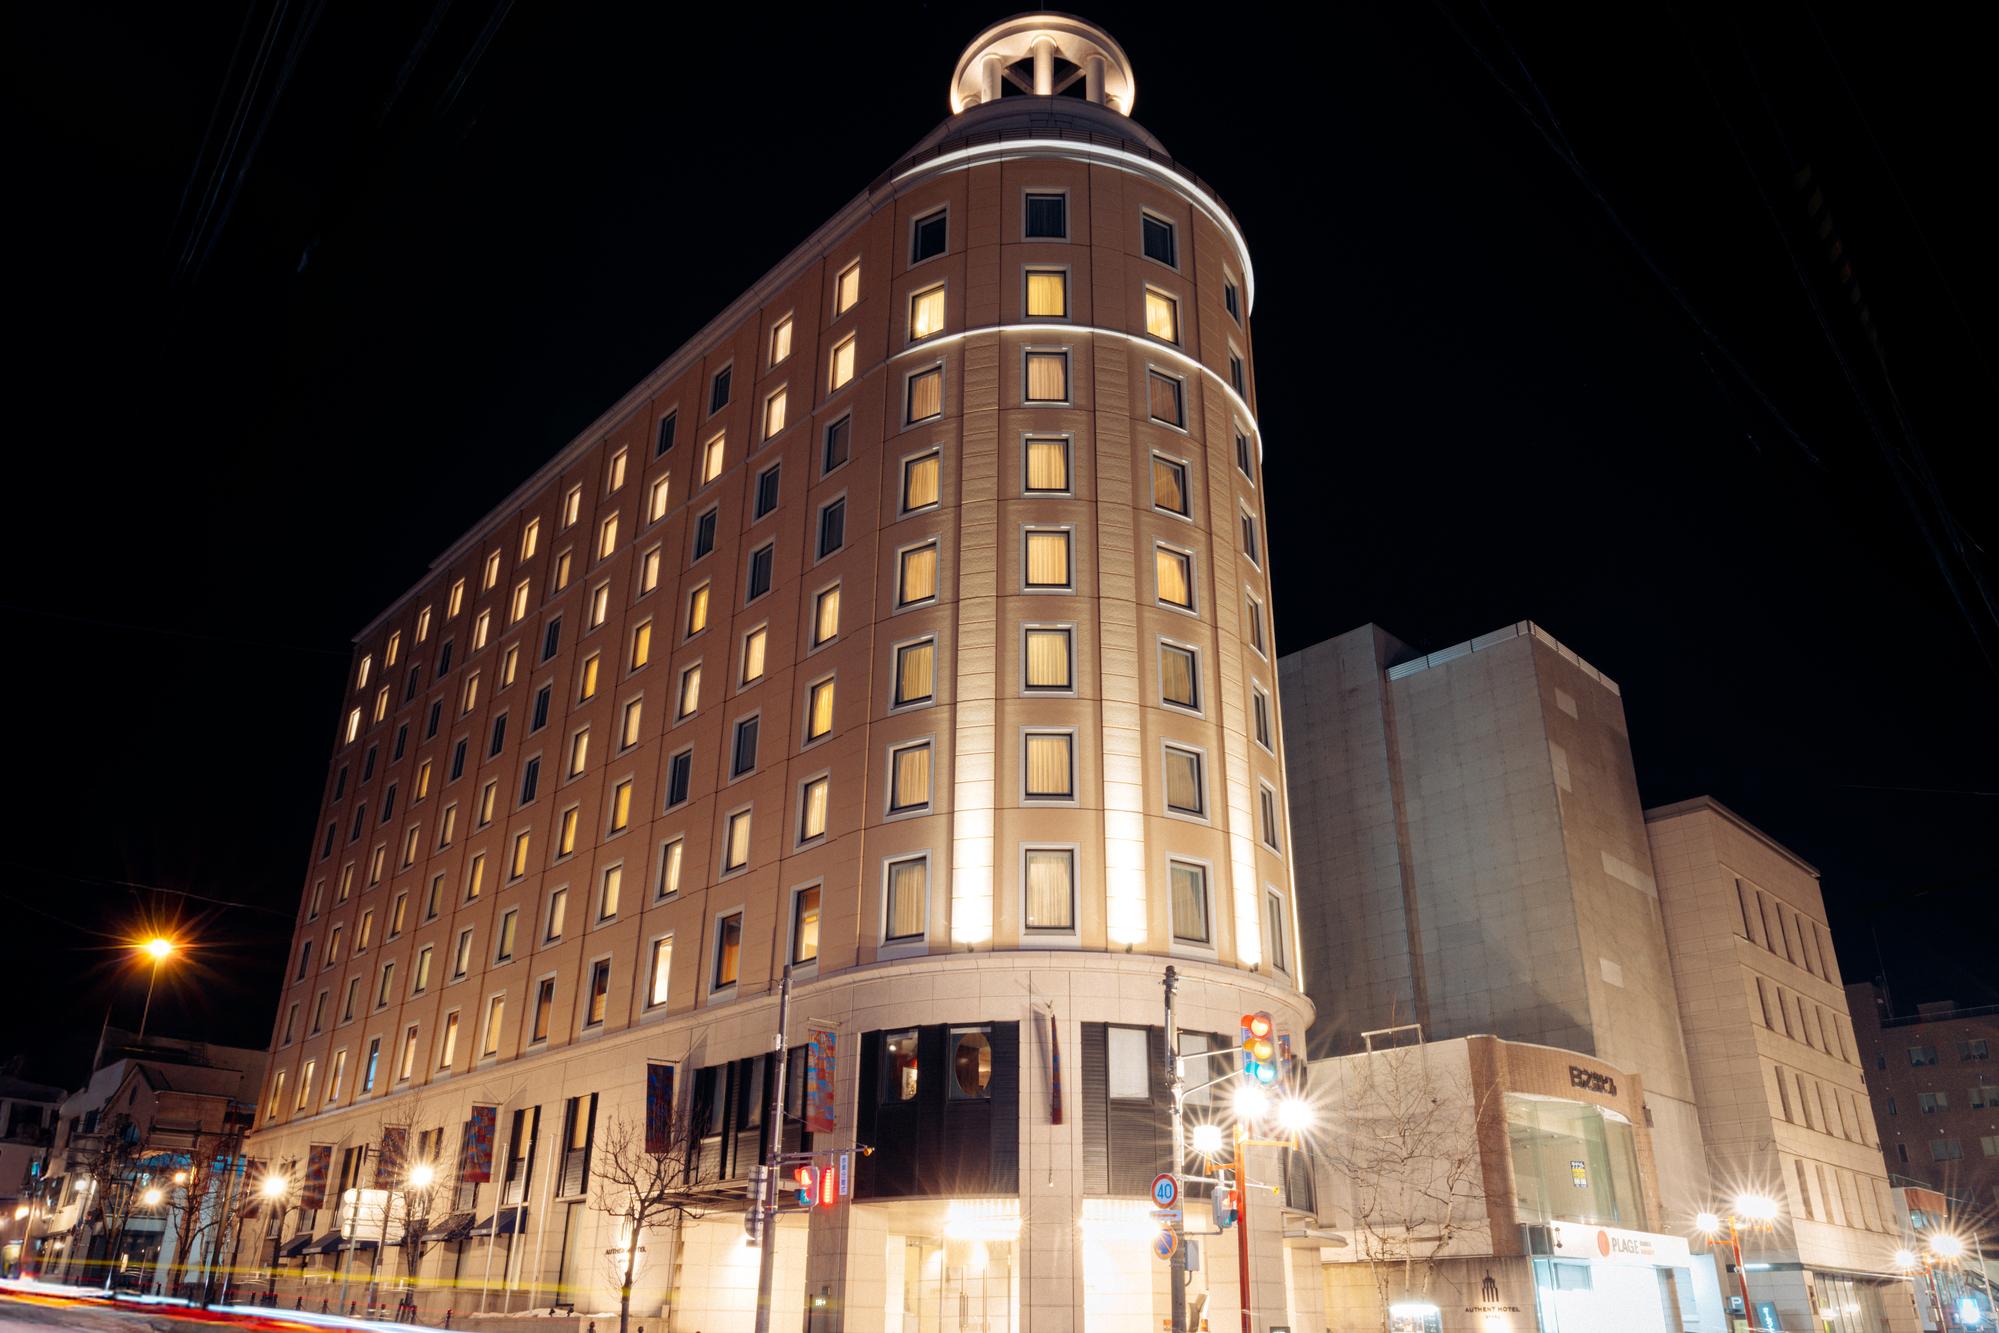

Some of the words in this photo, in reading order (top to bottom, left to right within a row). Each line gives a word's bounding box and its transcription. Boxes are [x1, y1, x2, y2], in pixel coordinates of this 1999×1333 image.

[1157, 1183, 1173, 1199] 40
[1611, 1237, 1640, 1254] PLAGE
[1730, 1296, 1742, 1309] P
